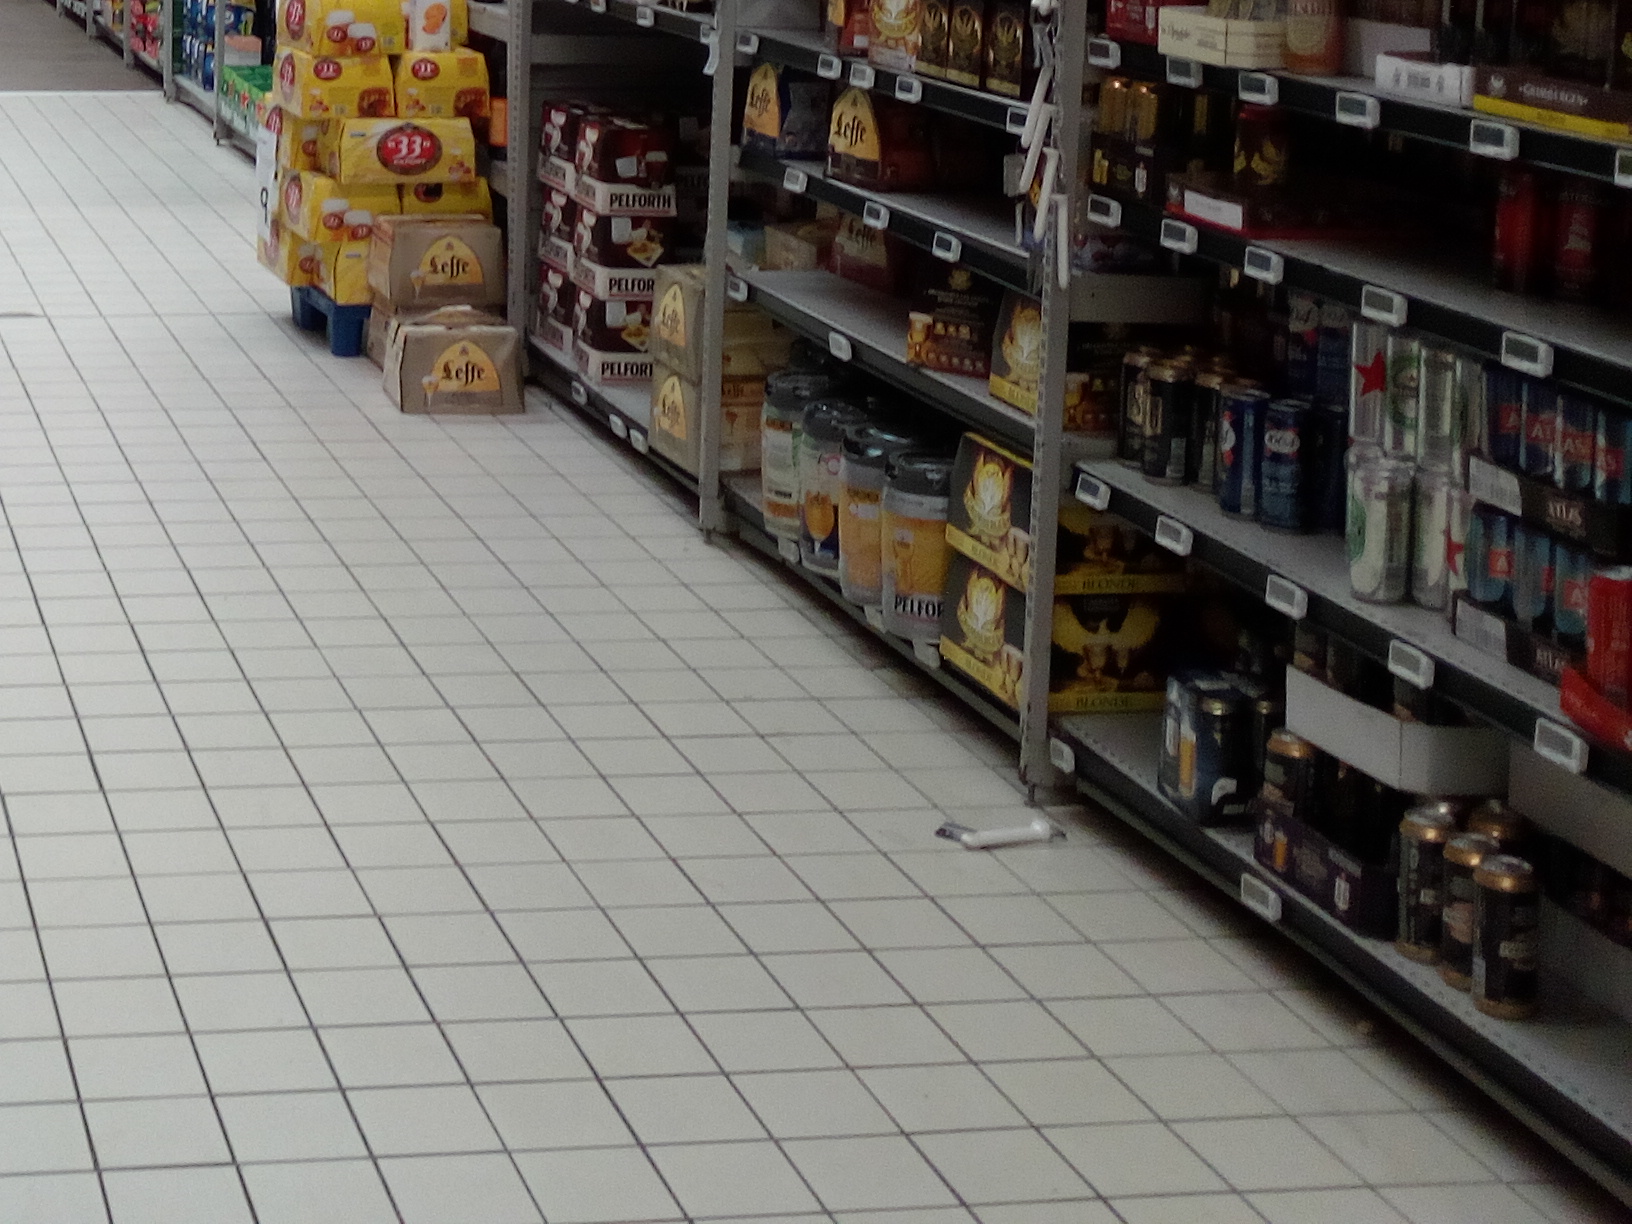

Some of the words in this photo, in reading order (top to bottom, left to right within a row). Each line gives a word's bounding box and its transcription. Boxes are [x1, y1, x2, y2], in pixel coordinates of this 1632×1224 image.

[834, 110, 867, 147] Leffe
[609, 192, 672, 209] PELFORTH
[428, 254, 470, 279] Leffe
[442, 358, 486, 387] Leffe
